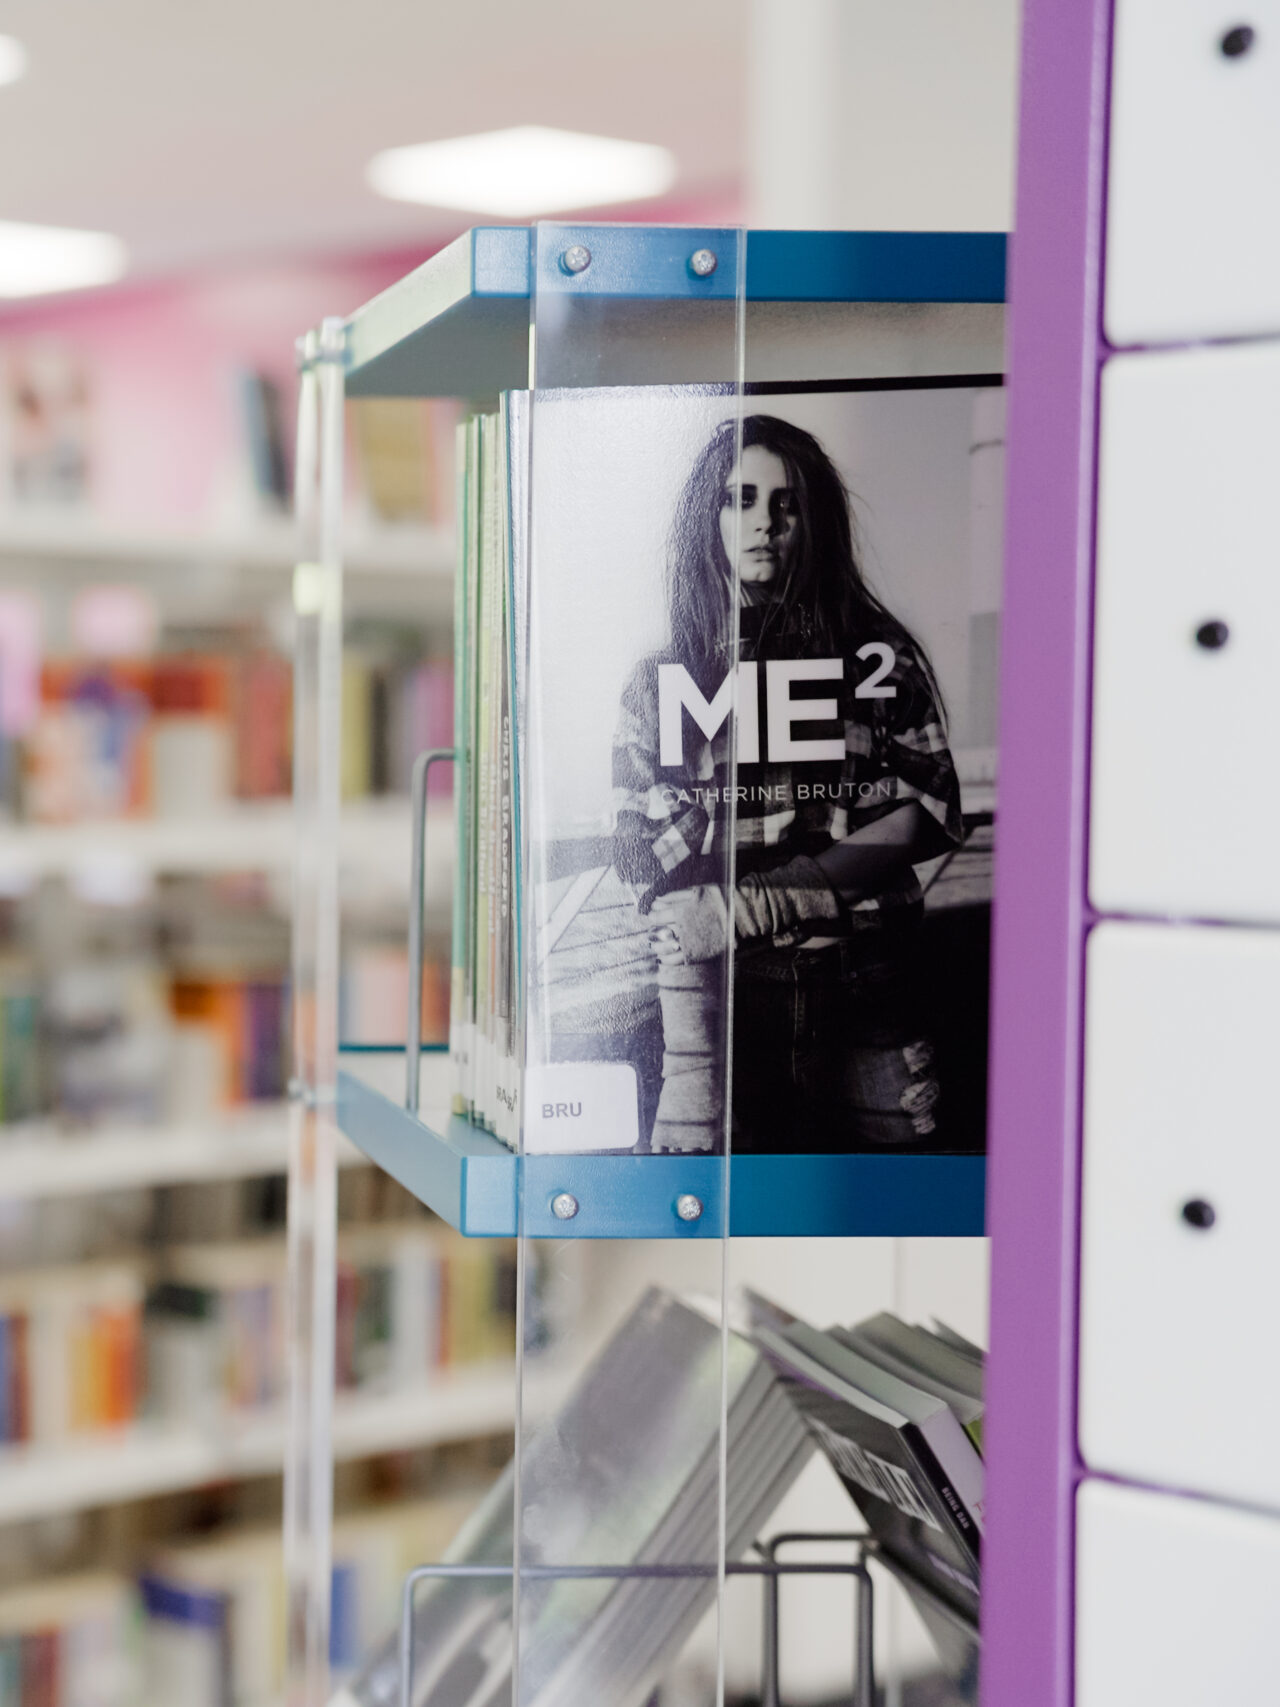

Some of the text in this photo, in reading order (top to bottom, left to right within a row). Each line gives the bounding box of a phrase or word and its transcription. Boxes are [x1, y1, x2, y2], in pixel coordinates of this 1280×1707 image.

[661, 782, 891, 804] CATHERINE BRUTON
[541, 1102, 583, 1119] BRU
[942, 1487, 960, 1511] BEING
